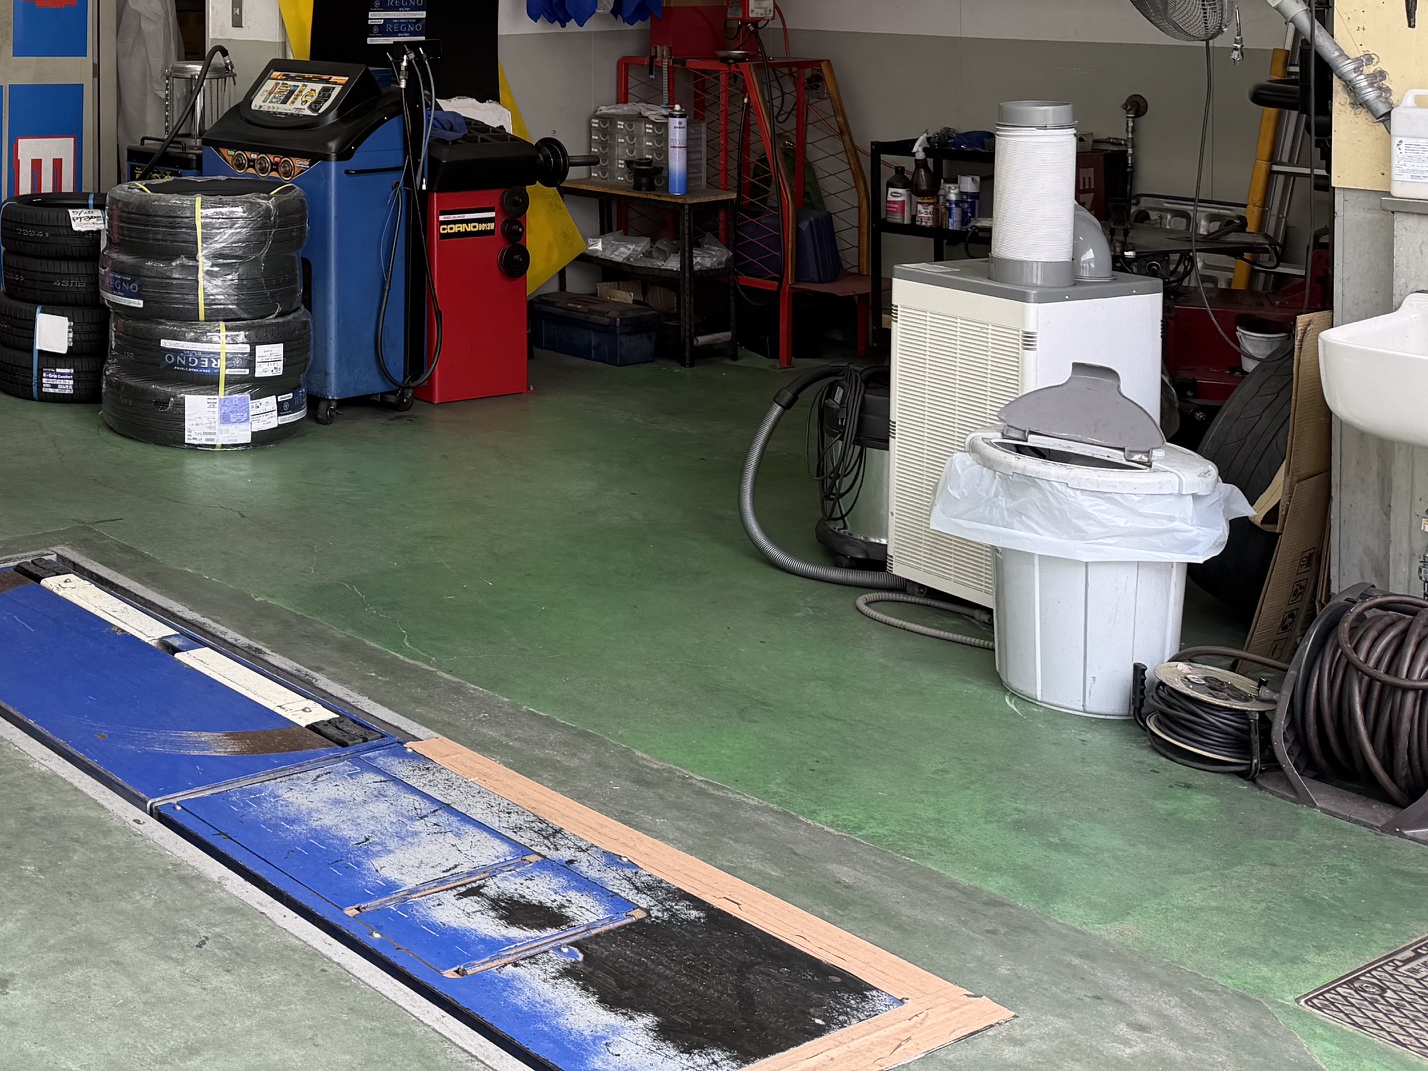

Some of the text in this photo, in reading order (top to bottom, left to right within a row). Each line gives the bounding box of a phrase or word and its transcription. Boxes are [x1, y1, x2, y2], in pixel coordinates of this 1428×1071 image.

[386, 23, 422, 32] REGNO
[440, 222, 479, 234] CORNO
[110, 279, 139, 293] EGNO
